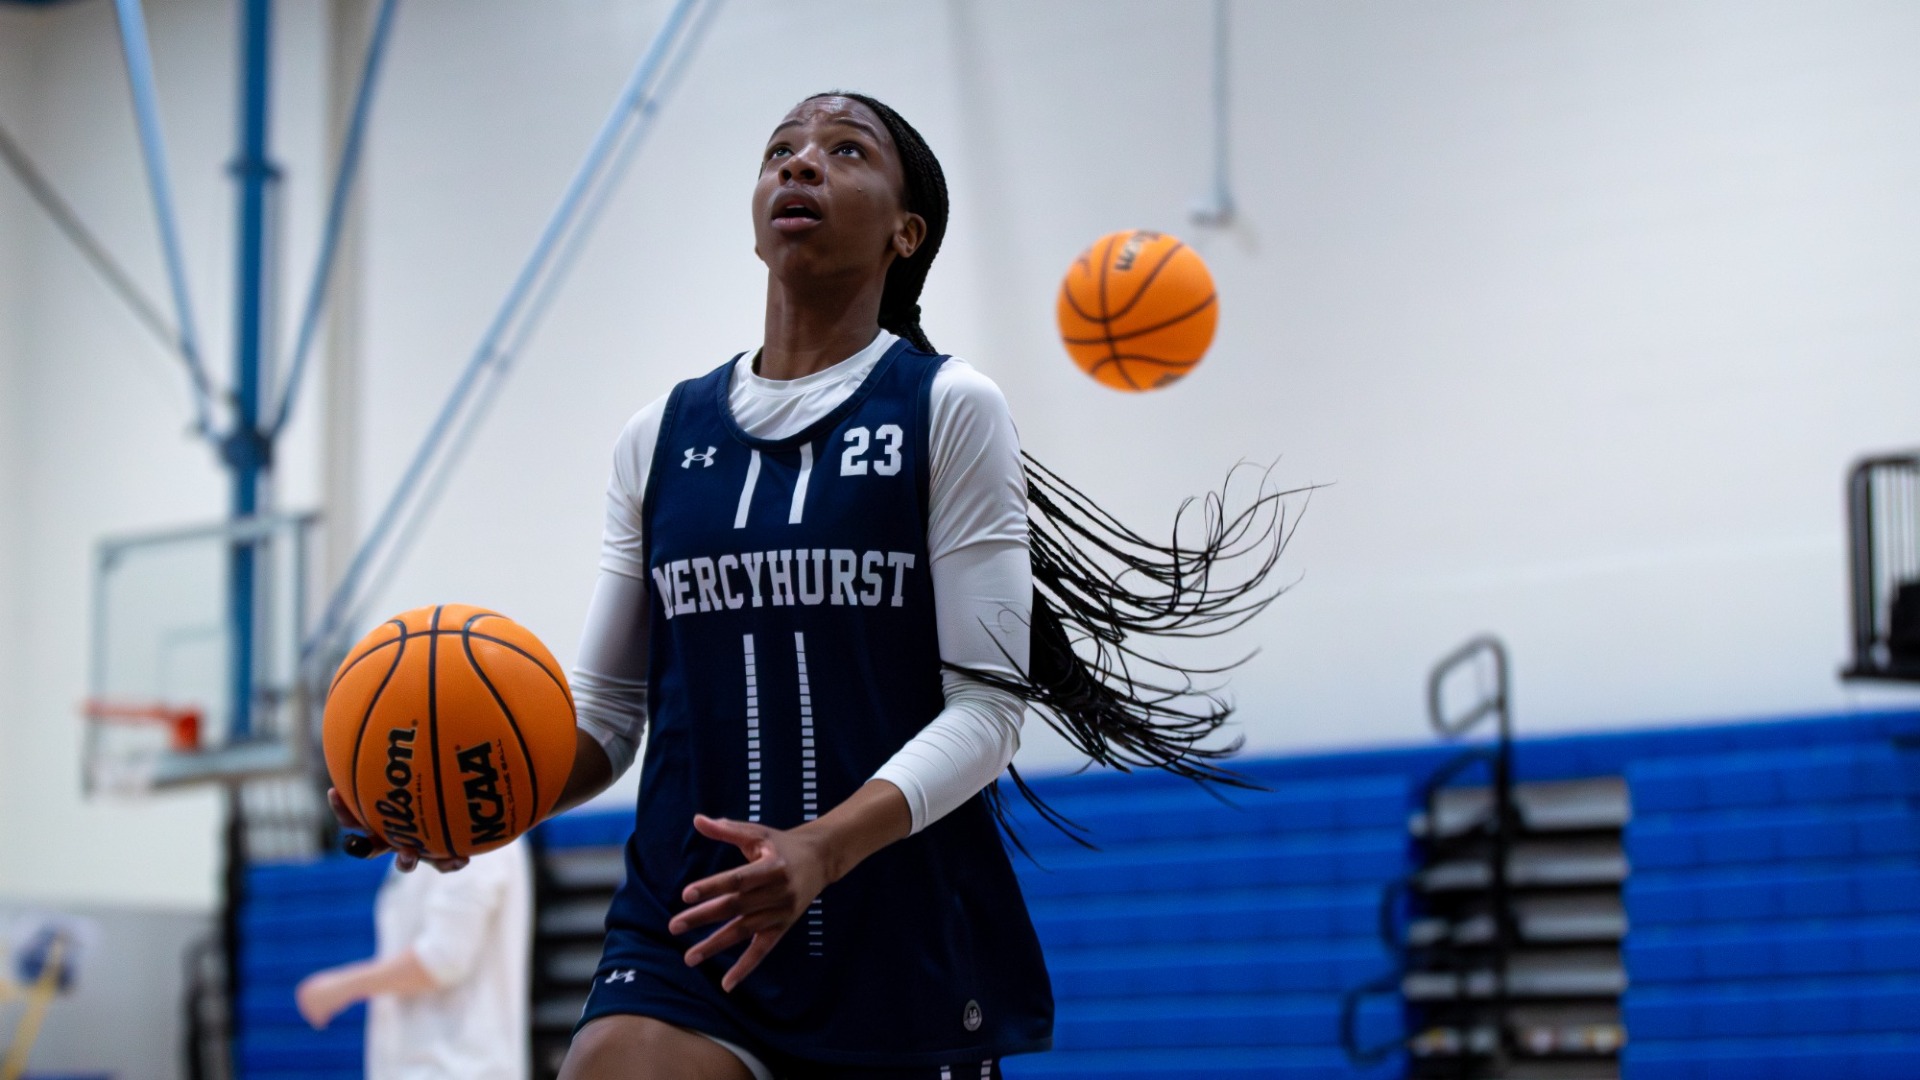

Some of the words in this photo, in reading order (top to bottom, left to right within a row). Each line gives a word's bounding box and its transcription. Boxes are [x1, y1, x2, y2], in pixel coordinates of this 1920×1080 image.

[840, 424, 903, 477] 23
[651, 549, 916, 620] MERCYHURST
[456, 741, 508, 846] NCAA
